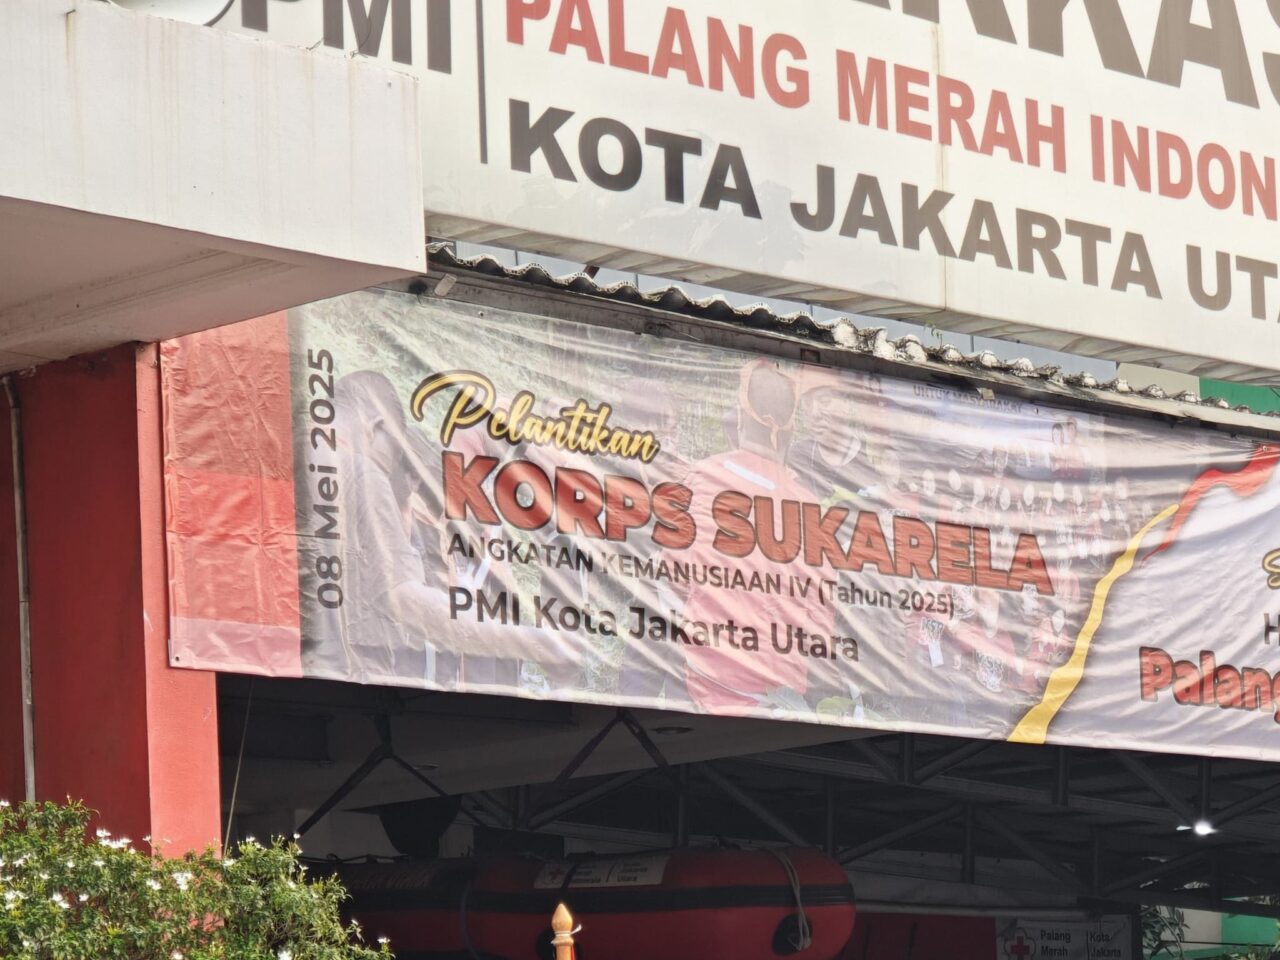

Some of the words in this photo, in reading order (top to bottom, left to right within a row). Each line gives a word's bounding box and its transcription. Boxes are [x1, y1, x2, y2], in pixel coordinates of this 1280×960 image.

[506, 0, 810, 108] PALANG
[835, 48, 1067, 175] MERAH
[508, 98, 762, 220] KOTA
[790, 164, 1163, 300] JAKARTA
[307, 348, 337, 448] 2025
[410, 369, 661, 464] Pelantikan
[309, 463, 340, 541] Mei
[442, 451, 697, 549] KORPS
[712, 490, 1055, 596] SUKARELA
[315, 555, 344, 610] 08
[447, 532, 594, 574] ANGKATAN
[601, 551, 781, 596] KEMANUSIAAN
[789, 577, 813, 599] IV
[819, 577, 892, 609] (Tahun
[898, 588, 955, 621] 2025)
[449, 587, 520, 627] PMI
[535, 595, 618, 638] Kota
[629, 605, 759, 653] Jakarta
[770, 623, 860, 663] Utara
[1040, 930, 1071, 944] Palang
[1041, 945, 1068, 957] Merah
